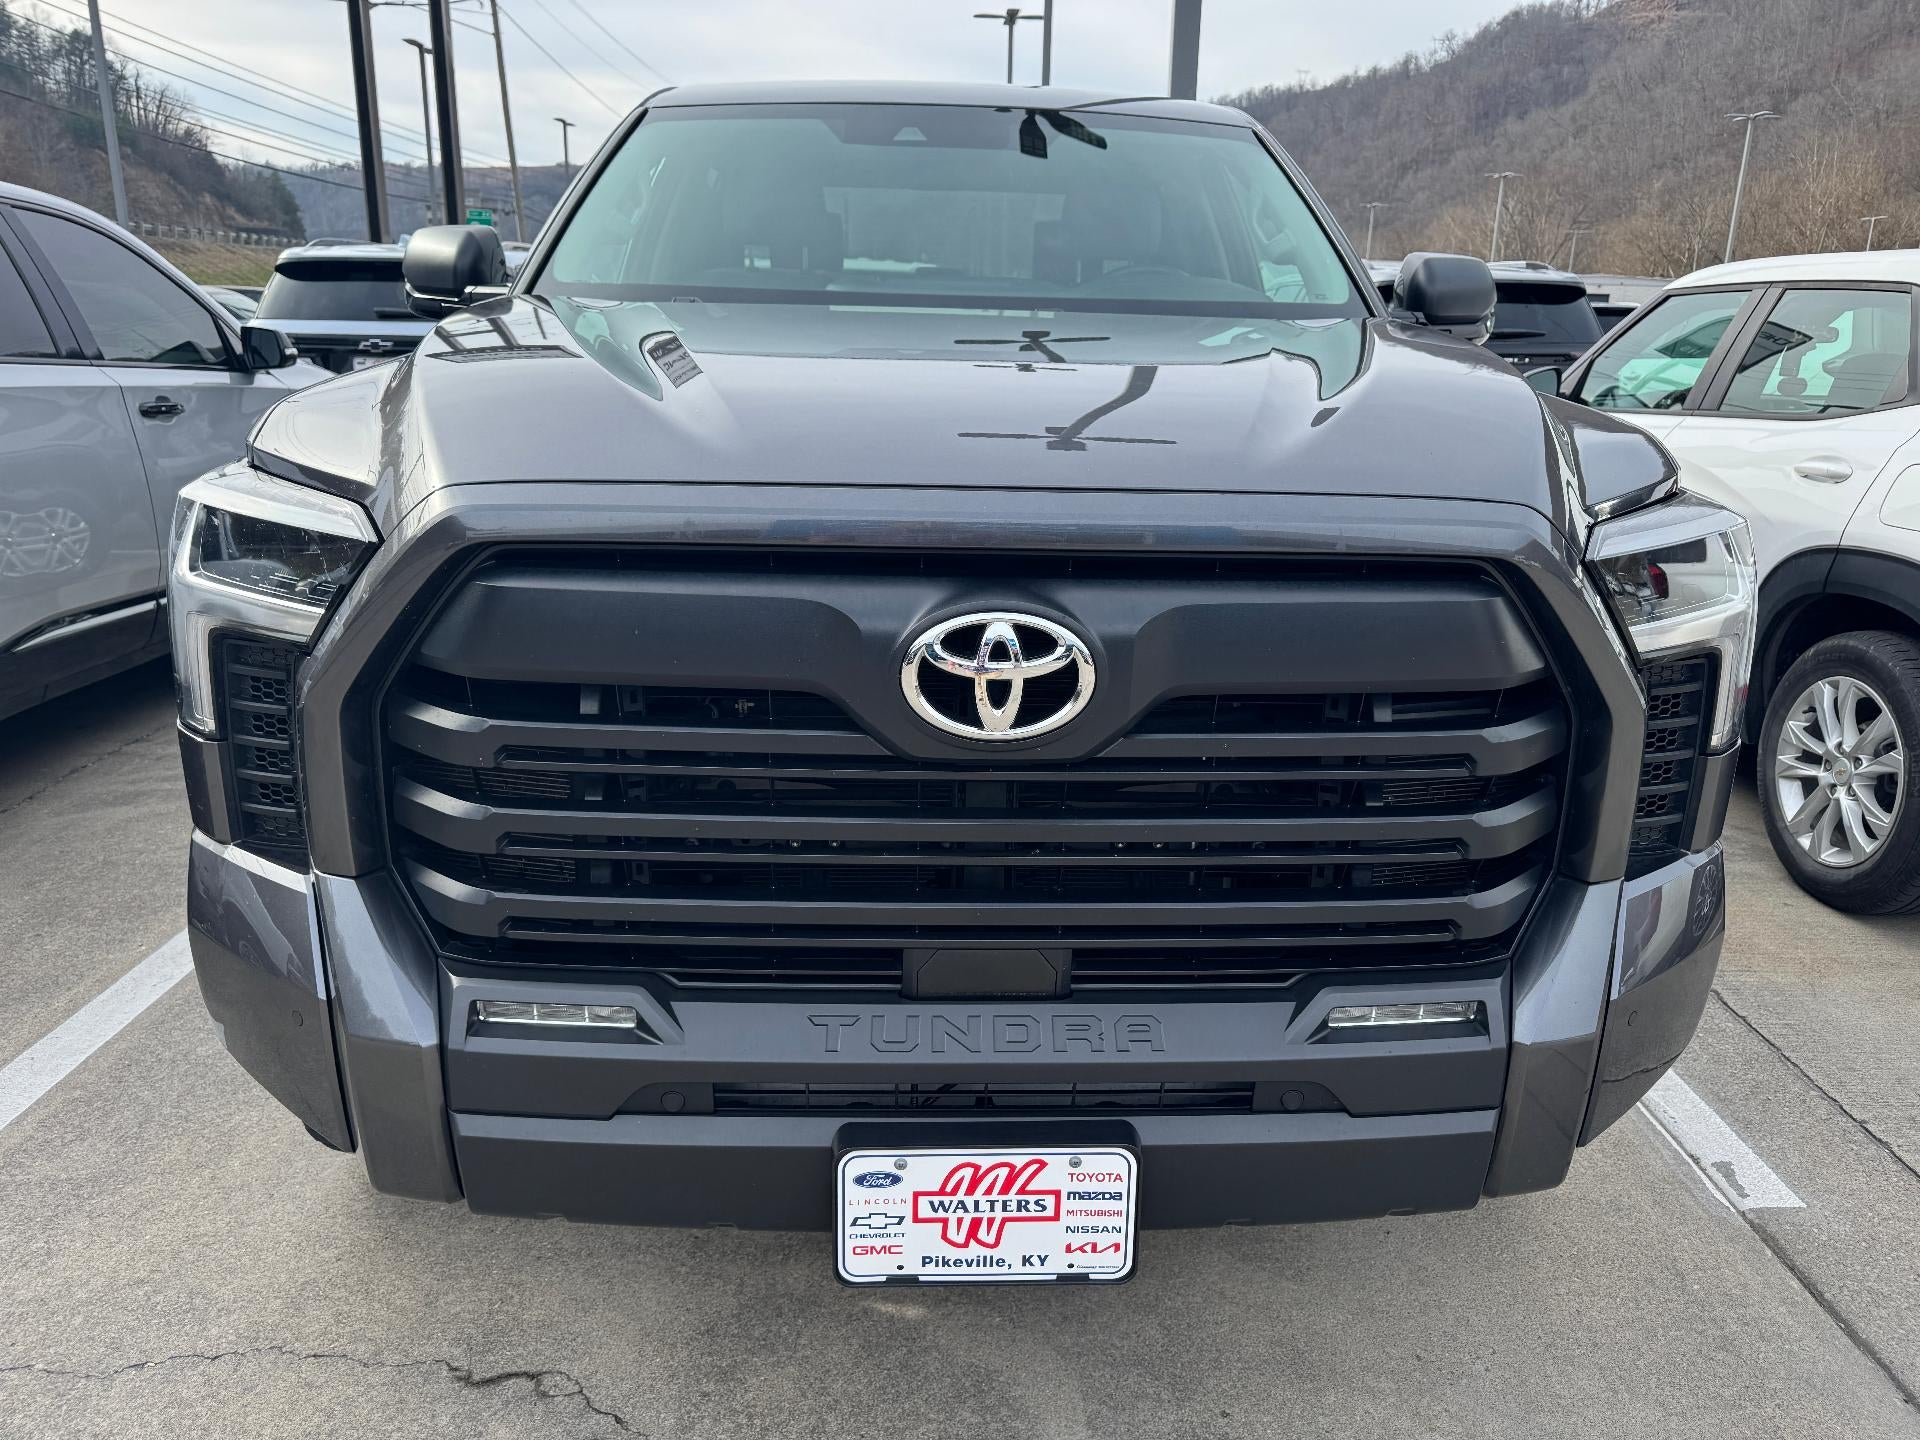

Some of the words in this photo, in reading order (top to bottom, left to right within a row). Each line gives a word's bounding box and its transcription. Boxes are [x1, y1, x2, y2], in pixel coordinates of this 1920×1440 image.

[807, 1014, 1165, 1053] TUNDRA
[863, 1174, 893, 1187] Ford
[1067, 1172, 1123, 1183] TOYOTA
[849, 1198, 907, 1206] LINCOLN
[928, 1198, 1048, 1214] WALTERS
[1066, 1209, 1122, 1218] MITSUBISHI
[1065, 1225, 1121, 1234] NISSAN
[849, 1232, 906, 1240] CHEVROLET
[852, 1244, 903, 1256] GMC
[1065, 1242, 1120, 1253] KIA
[921, 1255, 1012, 1270] Pikeville,
[1020, 1254, 1050, 1267] KY
